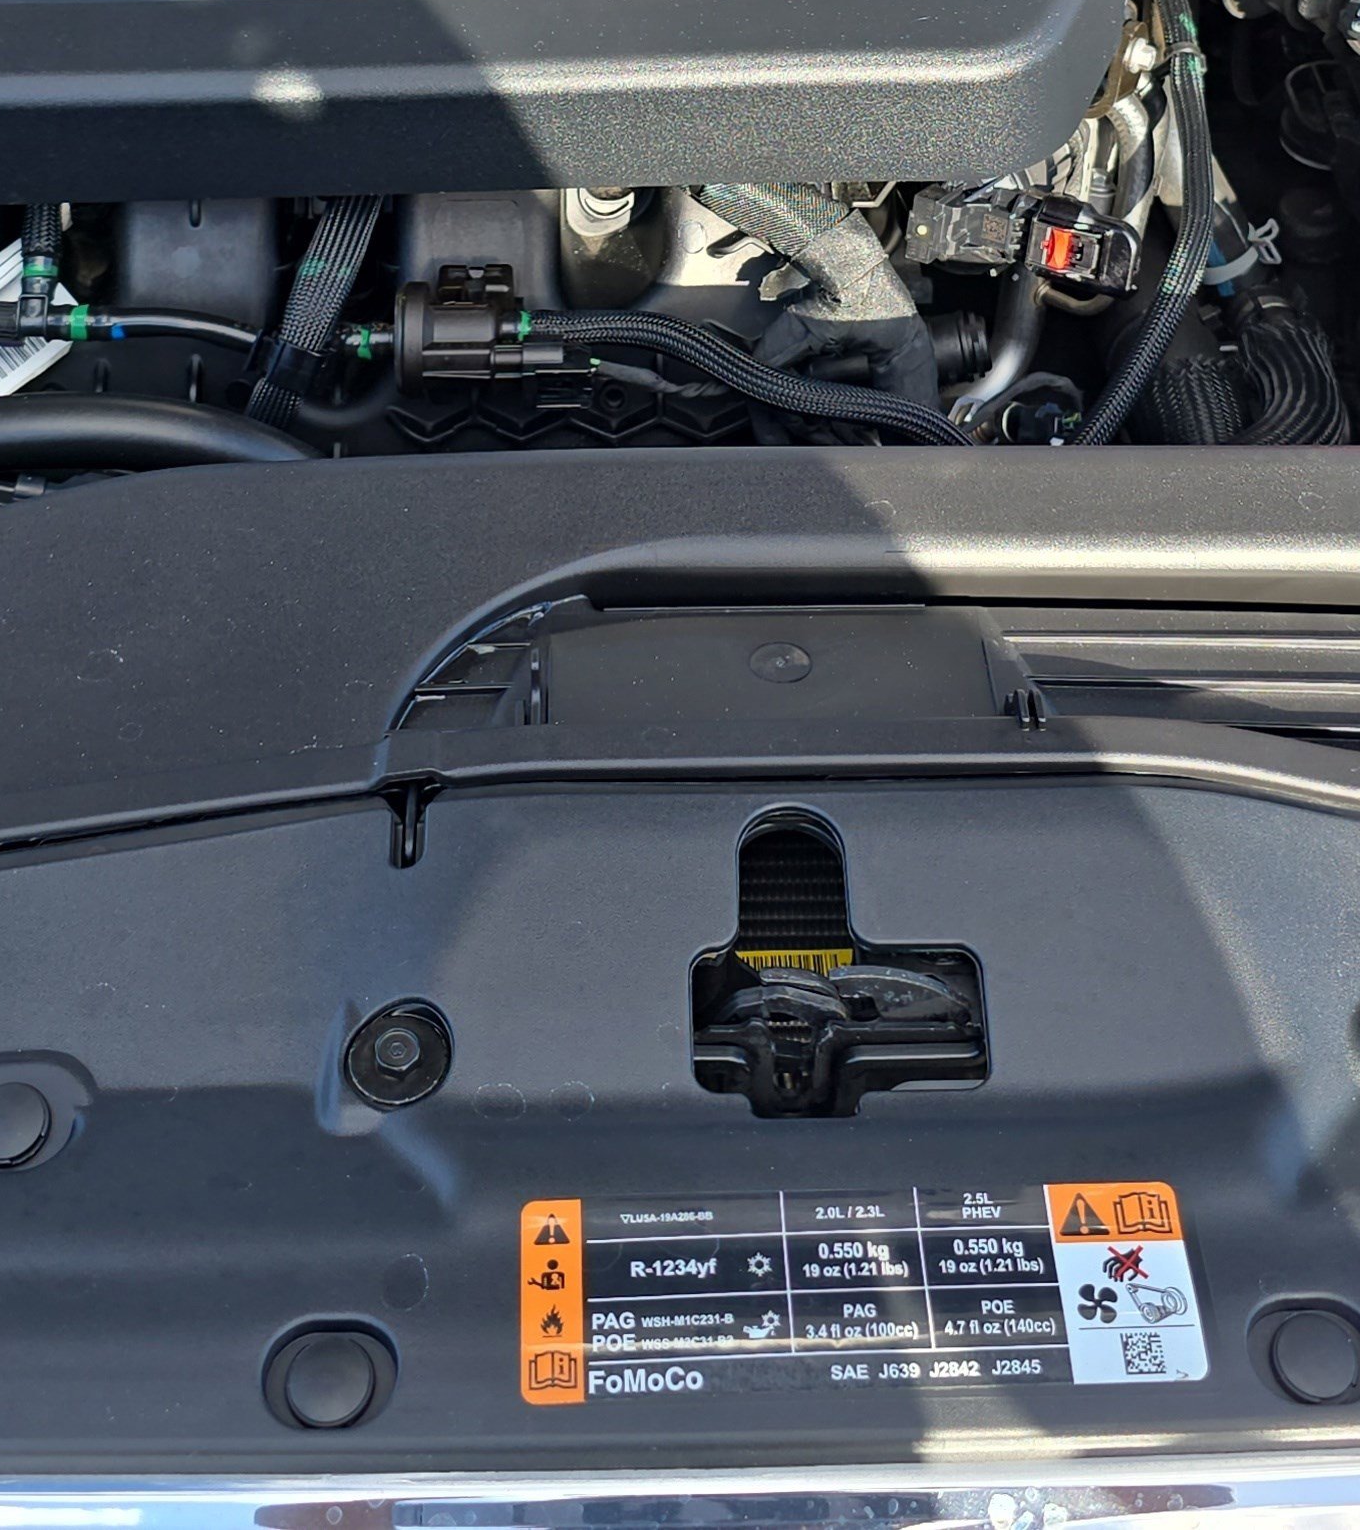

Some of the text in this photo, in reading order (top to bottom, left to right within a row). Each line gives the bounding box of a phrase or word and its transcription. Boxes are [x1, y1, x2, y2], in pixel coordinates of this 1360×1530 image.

[963, 1192, 993, 1205] 2.5L
[815, 1206, 845, 1219] 2.0L
[855, 1205, 885, 1218] 2.3L
[962, 1206, 1001, 1219] PHEV
[818, 1241, 890, 1262] 0.550 kg
[953, 1237, 1024, 1257] 0.550 kg
[630, 1258, 717, 1278] R-1234yf
[802, 1260, 909, 1279] 19 oz (1.21 lbs)
[939, 1256, 1044, 1275] 19 oz (1.21 lbs)
[843, 1303, 877, 1318] PAG
[981, 1300, 1015, 1315] POE
[591, 1311, 734, 1330] PAG WSH-M1C231-B
[944, 1317, 1055, 1336] 4.7 fl oz (140cc)
[805, 1321, 919, 1340] 3.4 fl oz (100cc)
[591, 1334, 637, 1352] POE
[830, 1359, 1041, 1380] SAE J639 J2842 J2845
[588, 1366, 704, 1394] FoMoCo
